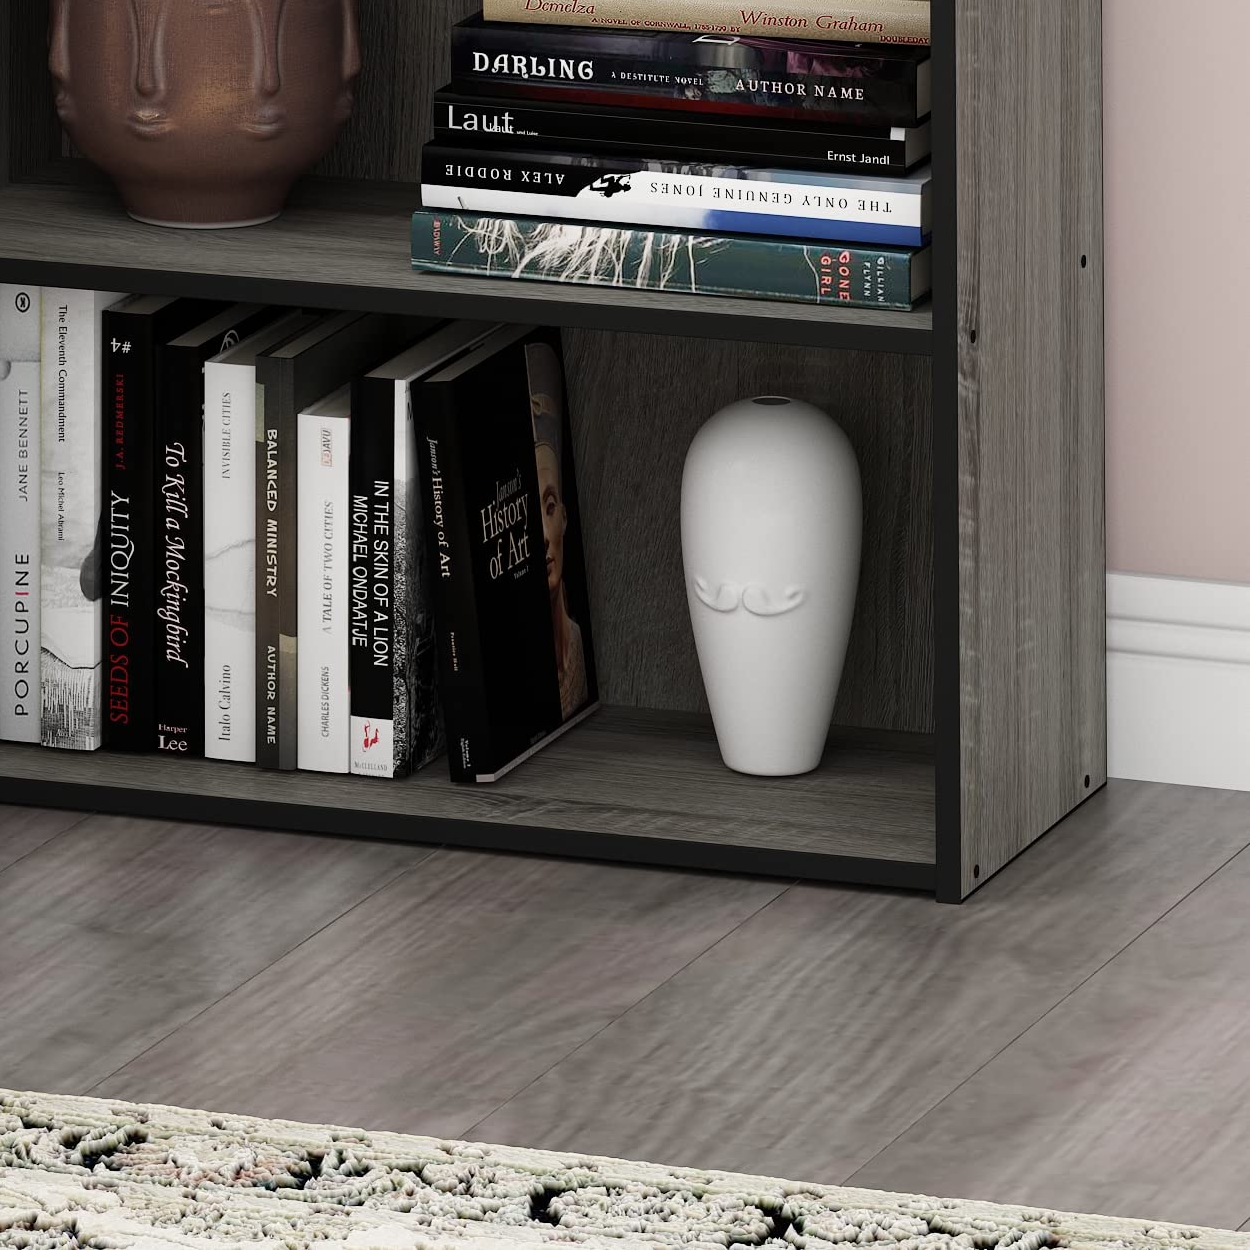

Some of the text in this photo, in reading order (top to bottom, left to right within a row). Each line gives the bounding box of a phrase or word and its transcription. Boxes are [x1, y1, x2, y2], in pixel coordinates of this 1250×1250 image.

[600, 18, 628, 26] NOVEL
[630, 19, 642, 27] OF
[730, 25, 741, 33] BY
[739, 9, 885, 33] Winston Graham
[880, 35, 929, 45] DOUBLEDAY
[472, 51, 594, 80] DARLING
[620, 71, 671, 83] DESTITUTE
[674, 76, 704, 86] NOVEL
[735, 79, 865, 101] AUTHOR NAME
[448, 105, 514, 134] Laut
[445, 164, 565, 184] ALEX RODDIE
[827, 150, 890, 165] Ernst Jandl
[650, 181, 892, 213] THE ONLY GENUINE JONES
[820, 255, 833, 295] GIRL
[838, 250, 851, 302] GONE
[862, 261, 872, 297] FLYNN
[876, 256, 886, 302] GILLIAN
[110, 337, 132, 354] #4
[58, 304, 68, 442] The Eleventh Commandment
[18, 389, 28, 502] JANE BENNETT
[221, 391, 231, 479] INVISIBLE CITIES
[57, 471, 66, 541] Leo Michel Abrami
[266, 429, 278, 598] BALANCED MINISTRY
[426, 435, 451, 578] Janson's History of Art
[480, 493, 529, 544] History
[157, 442, 189, 668] To Kill a Mockingbird
[322, 502, 334, 635] A TALE OF TWO CITIES
[352, 495, 368, 647] MICHAEL ONDAATJE
[372, 480, 389, 667] IN THE SKIN OF A LION
[489, 531, 531, 580] of Art
[110, 490, 135, 724] SEEDS OF INIQUITY
[14, 553, 29, 716] PORCUPINE
[218, 664, 231, 741] Italo Calvino
[267, 645, 276, 744] AUTHOR NAME
[320, 666, 330, 738] CHARLES DICKENS
[158, 723, 188, 734] Harper
[158, 735, 188, 751] Lee
